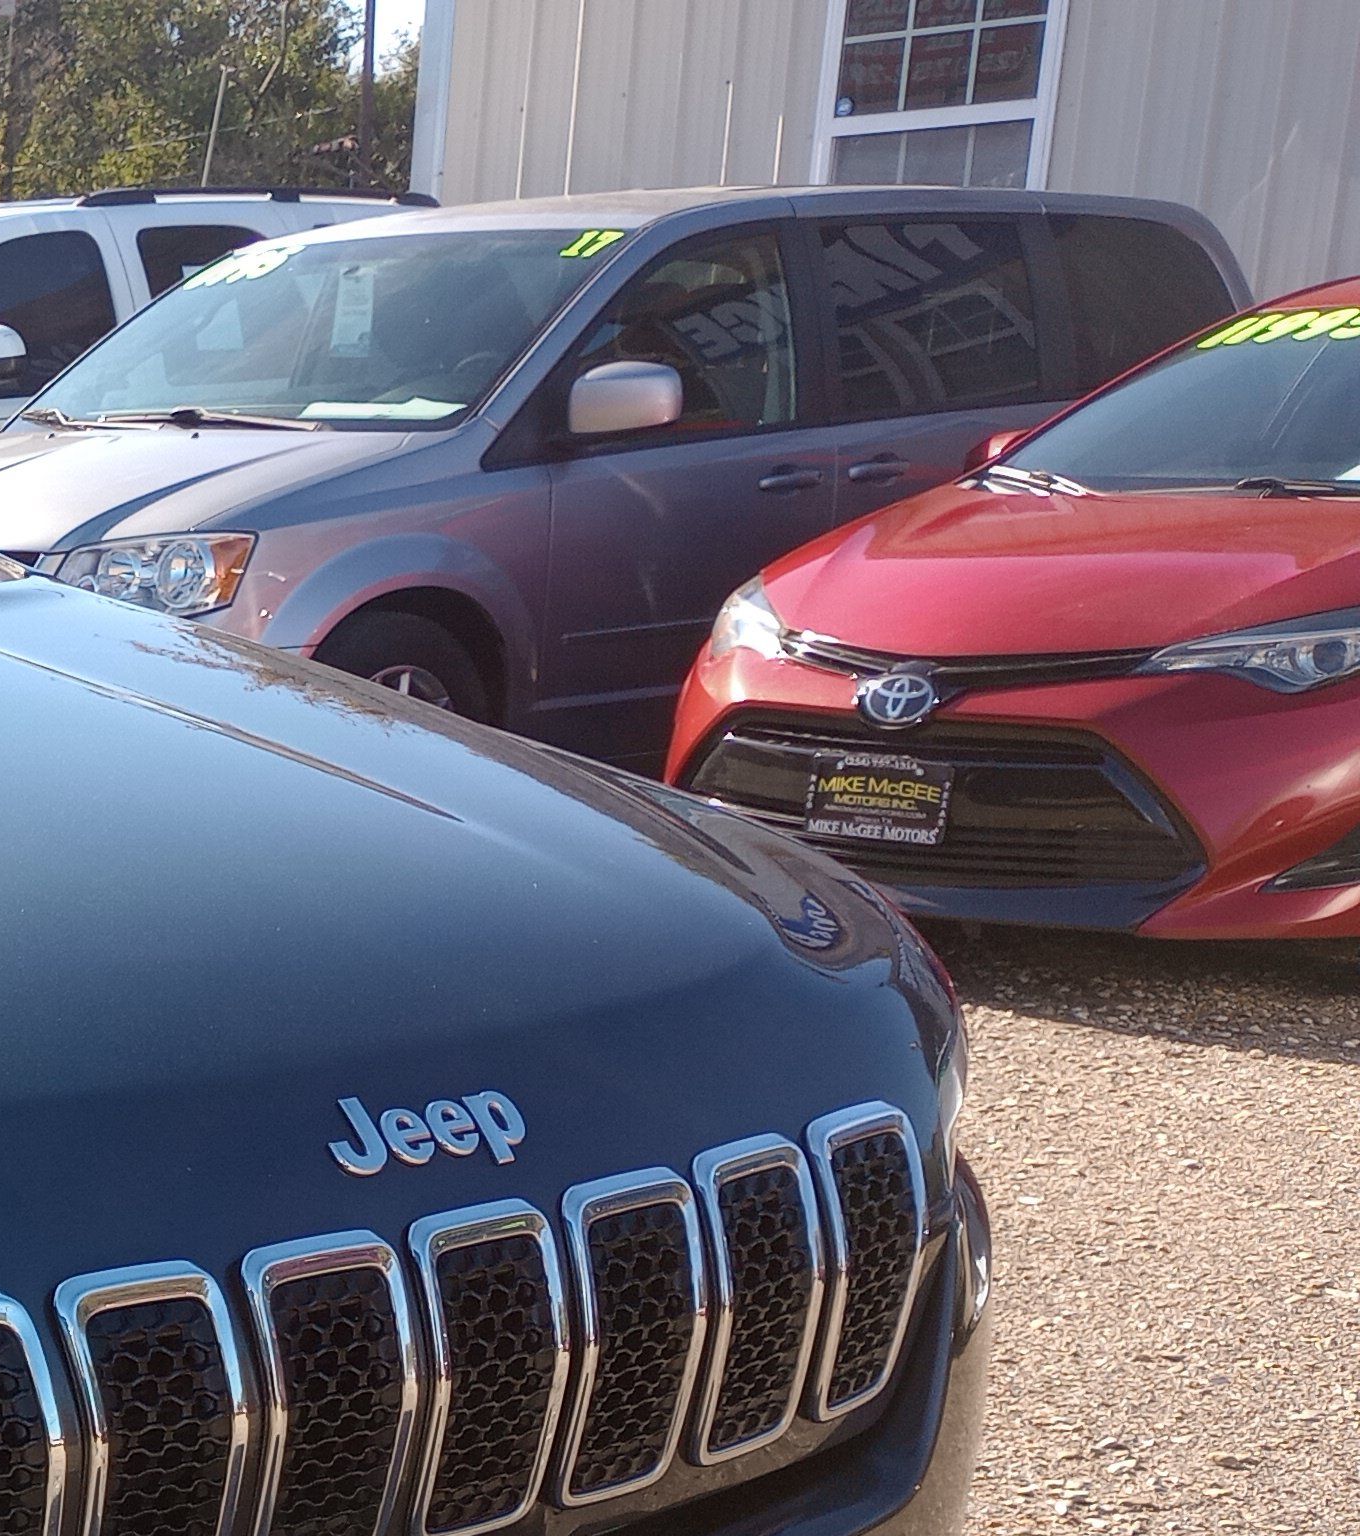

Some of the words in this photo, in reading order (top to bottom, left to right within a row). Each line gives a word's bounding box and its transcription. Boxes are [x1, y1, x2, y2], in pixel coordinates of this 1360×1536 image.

[559, 229, 625, 258] 17
[818, 776, 866, 793] MIKE
[867, 777, 942, 803] McGEE
[807, 818, 840, 835] MIKE
[883, 826, 938, 845] MOTORS
[328, 1090, 527, 1178] Jeep
